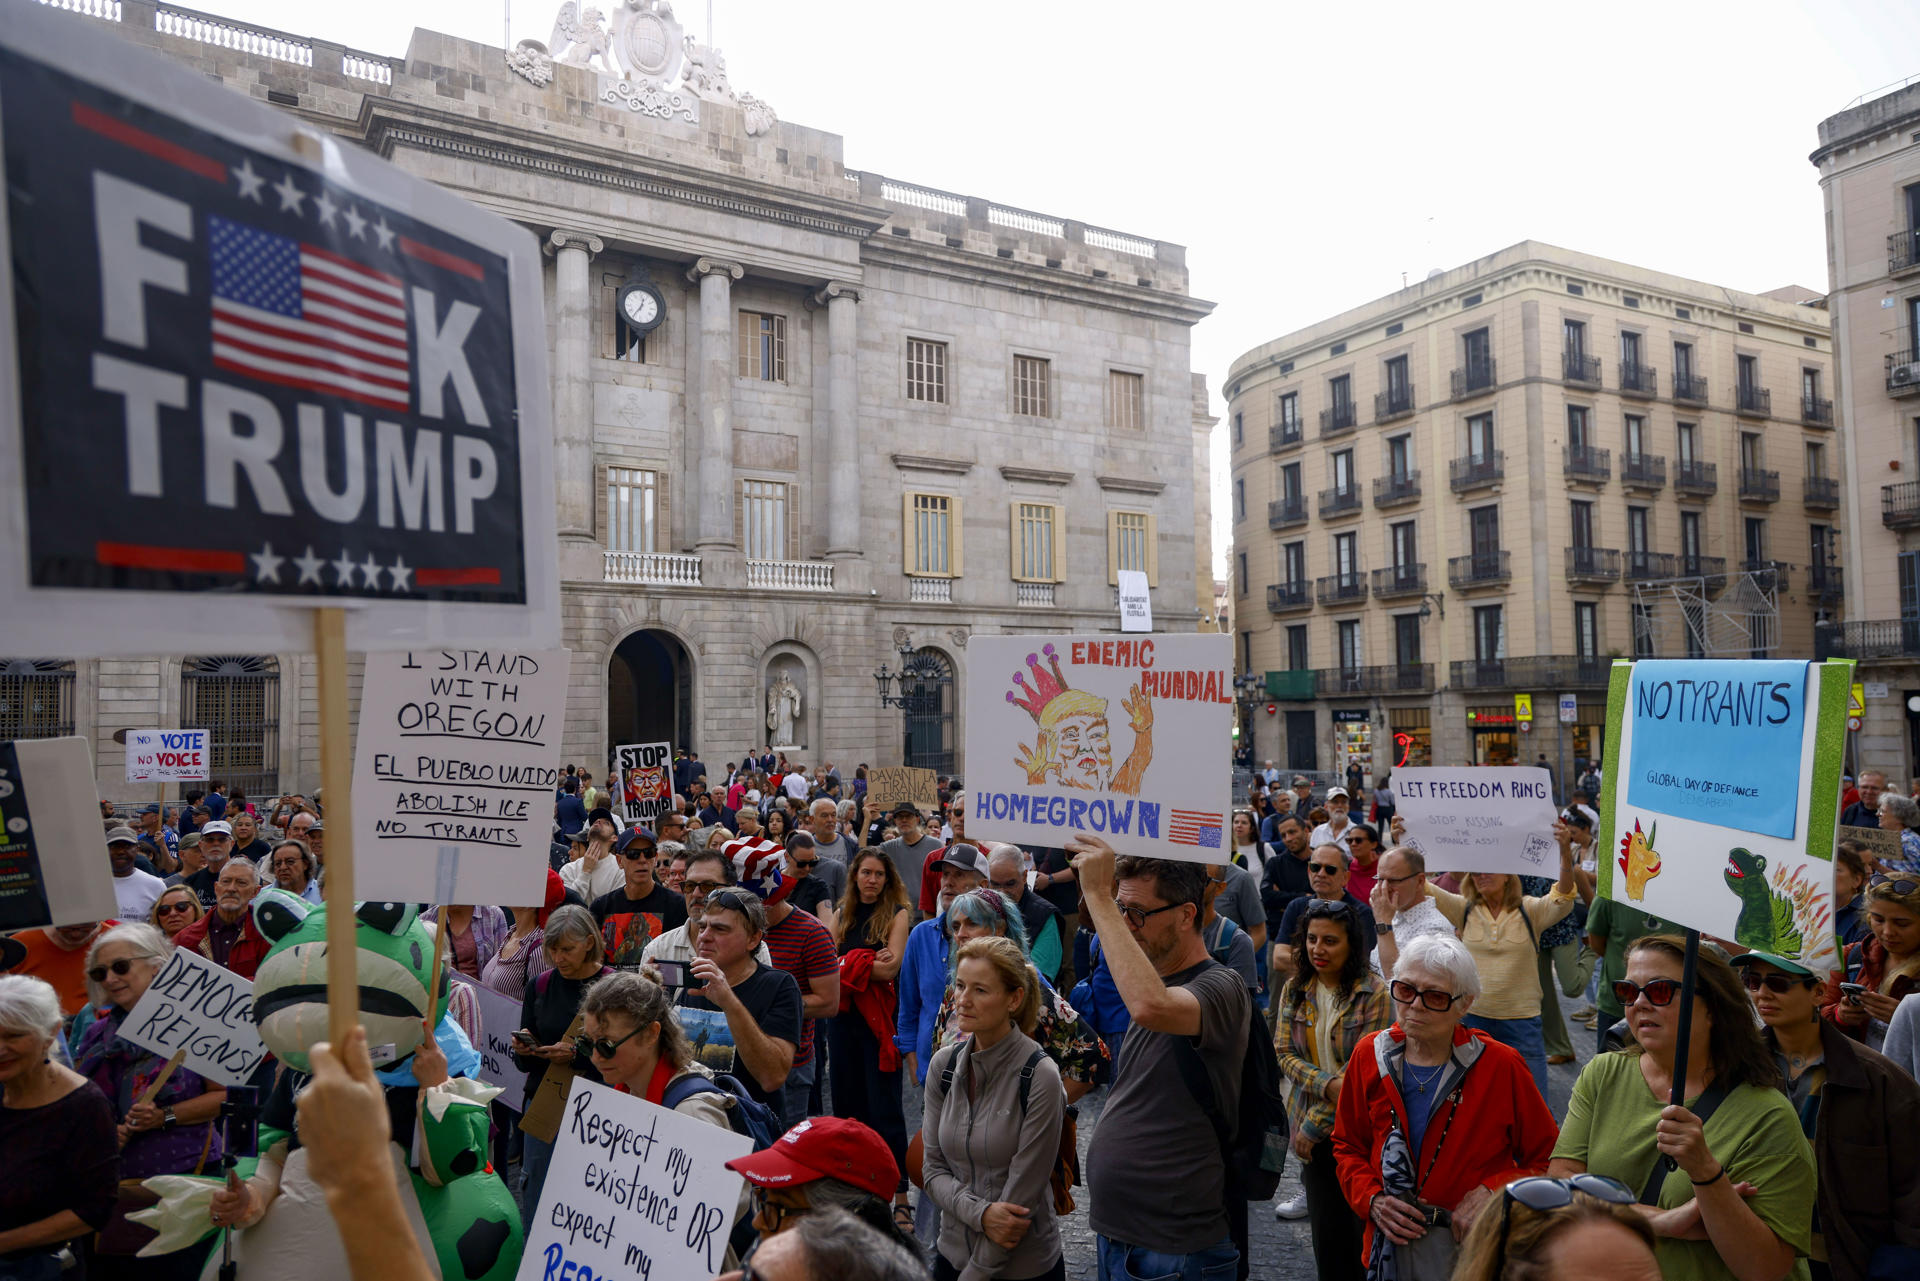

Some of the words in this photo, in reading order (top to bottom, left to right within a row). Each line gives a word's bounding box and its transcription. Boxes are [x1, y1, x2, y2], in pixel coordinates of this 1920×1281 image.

[93, 353, 498, 534] TRUMP
[439, 651, 538, 675] STAND
[1071, 639, 1154, 668] ENEMIC
[431, 678, 518, 702] WITH
[1141, 671, 1232, 704] MUNDIAL
[1639, 680, 1672, 720] NO
[1676, 679, 1791, 727] TYRANTS
[398, 702, 544, 738] OREGON
[137, 735, 151, 745] NO
[160, 733, 204, 749] VOTE
[138, 755, 153, 765] NO
[156, 752, 202, 767] VOICE
[375, 754, 403, 776] EL
[418, 756, 493, 780] PUEBLO
[500, 765, 557, 785] UNIDO
[620, 746, 668, 769] STOP
[870, 768, 918, 785] DAVANT
[923, 769, 937, 784] LA
[1400, 782, 1423, 797] LET
[1430, 782, 1504, 798] FREEDOM
[1512, 781, 1546, 799] RING
[1647, 770, 1681, 788] GLOBAL
[1684, 778, 1701, 792] DAY
[1701, 781, 1712, 793] OF
[1714, 783, 1759, 797] DEFIANCE
[397, 793, 487, 813] ABOLISH
[499, 800, 530, 816] ICE
[976, 792, 1160, 839] HOMEGROWN
[376, 820, 406, 833] NO
[425, 823, 517, 842] TYRANTS
[1428, 815, 1457, 825] STOP
[1464, 815, 1503, 829] KISSING
[1434, 836, 1471, 846] ORANGE
[137, 1003, 262, 1080] REIGNS!
[571, 1090, 659, 1162] Respect
[665, 1146, 693, 1197] my
[585, 1162, 678, 1232] existence
[687, 1202, 724, 1274] OR
[551, 1202, 616, 1249] expect
[624, 1243, 652, 1281] my
